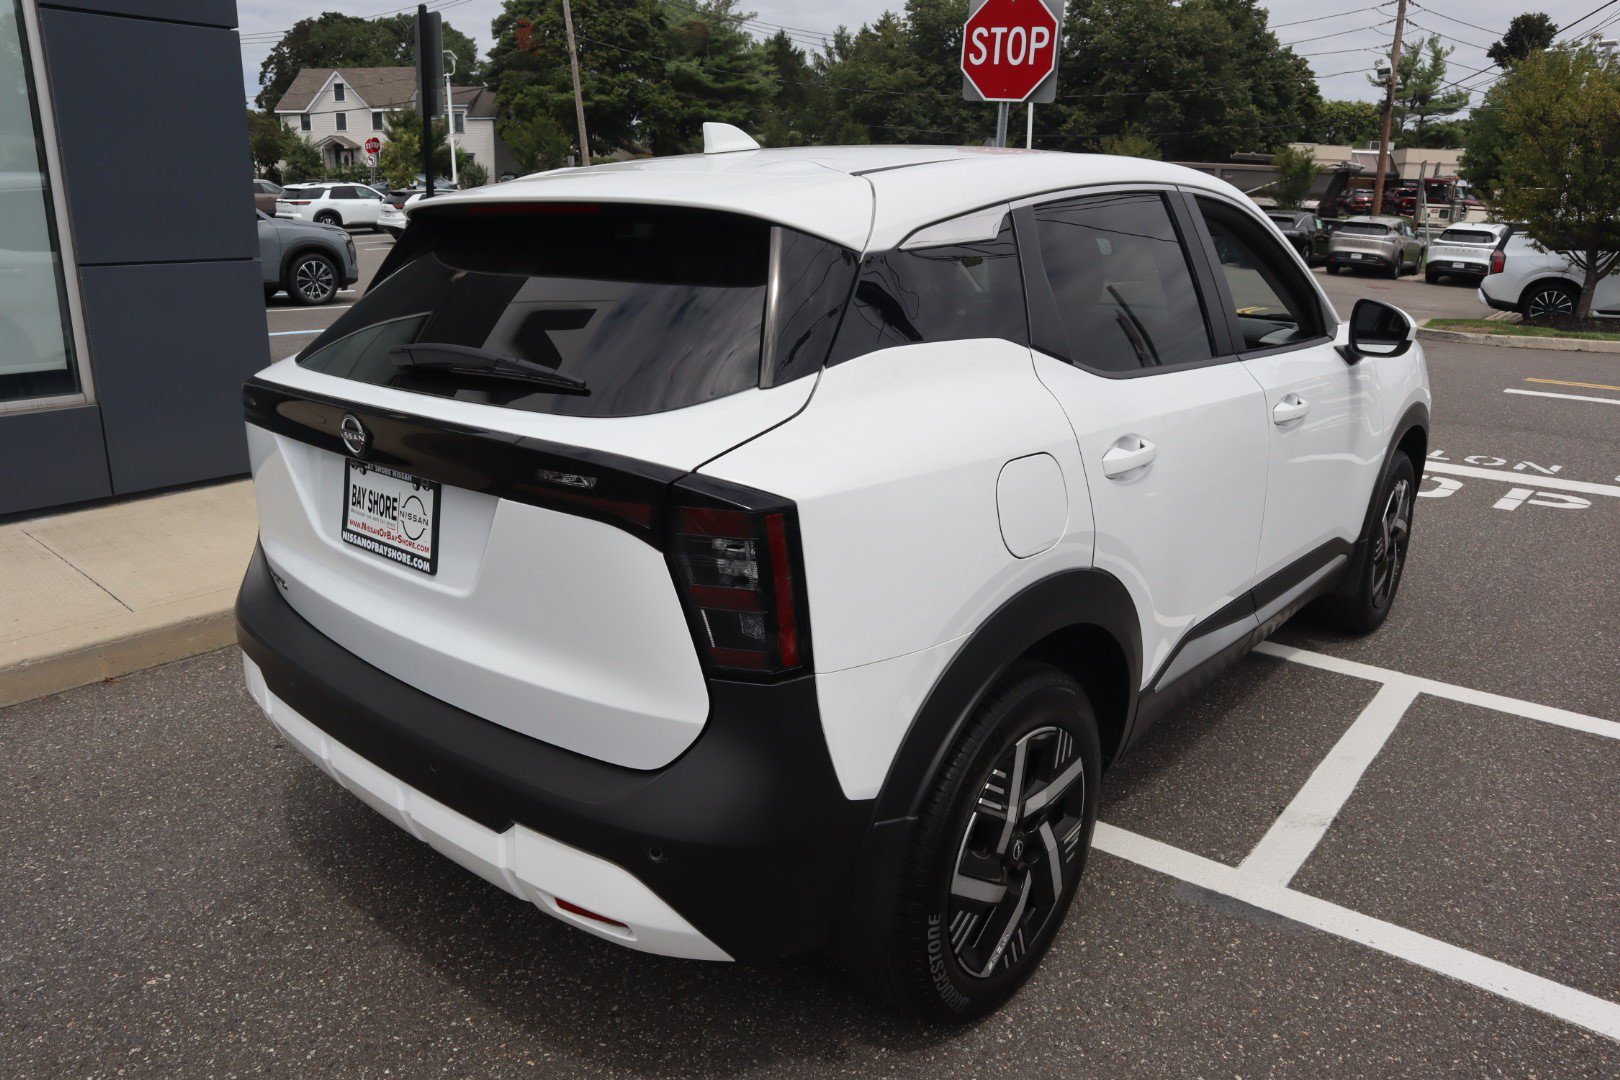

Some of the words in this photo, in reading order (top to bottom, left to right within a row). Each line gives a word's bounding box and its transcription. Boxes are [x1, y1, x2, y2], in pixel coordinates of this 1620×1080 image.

[969, 26, 1050, 65] STOP
[351, 484, 367, 509] BAY
[367, 489, 398, 521] SHORE
[400, 510, 429, 526] NISSAN
[342, 530, 430, 573] NISSANOFBAYSHORE.COM
[927, 912, 970, 1014] BRIDGESTONE
